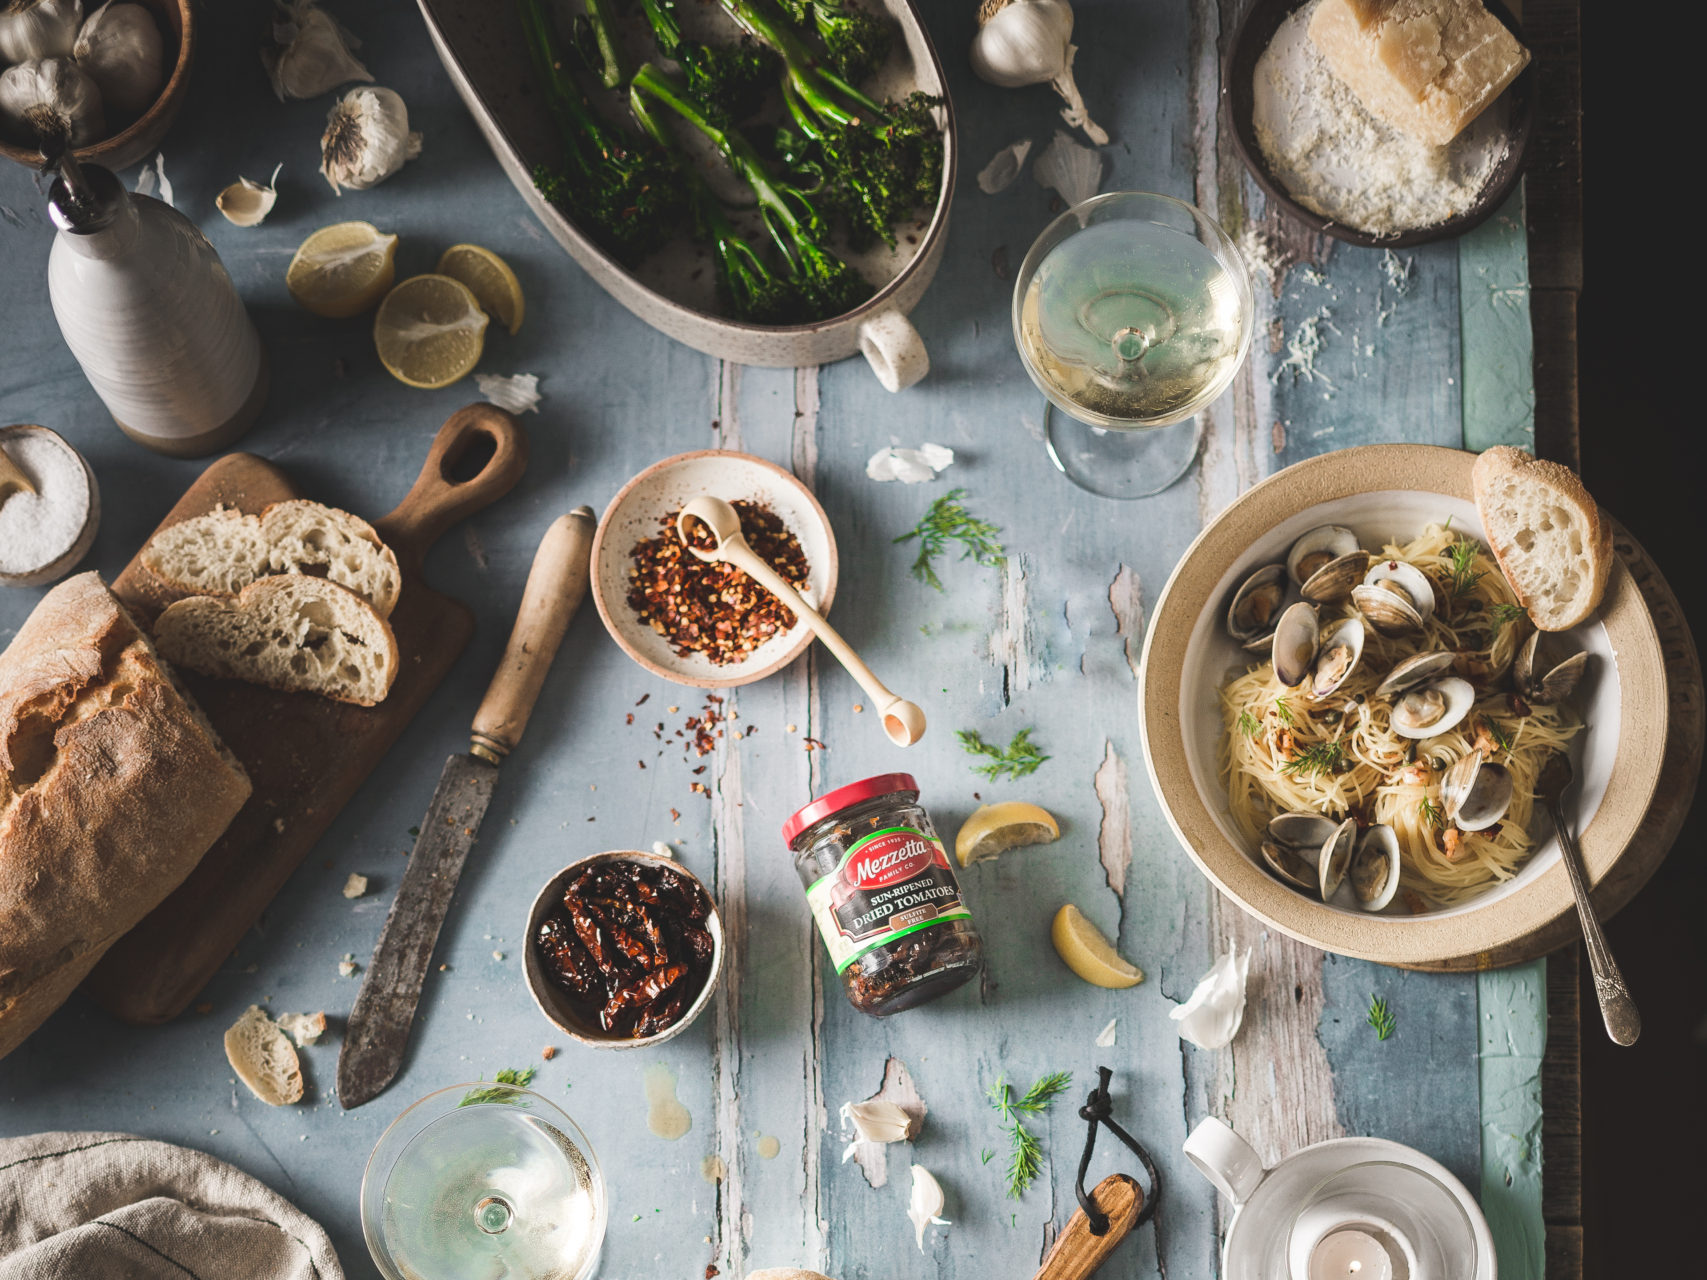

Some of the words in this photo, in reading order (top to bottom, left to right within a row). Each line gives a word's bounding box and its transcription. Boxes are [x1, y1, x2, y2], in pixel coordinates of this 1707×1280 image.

[868, 841, 886, 852] SINCE
[854, 839, 927, 887] Mezzetta
[878, 868, 903, 883] FAMILY
[904, 862, 915, 870] CO.
[871, 878, 933, 906] SUN-RIPENED
[853, 903, 894, 929] DRIED
[894, 886, 955, 909] TOMATOES
[900, 908, 926, 921] SULFITE
[907, 915, 924, 925] FREE
